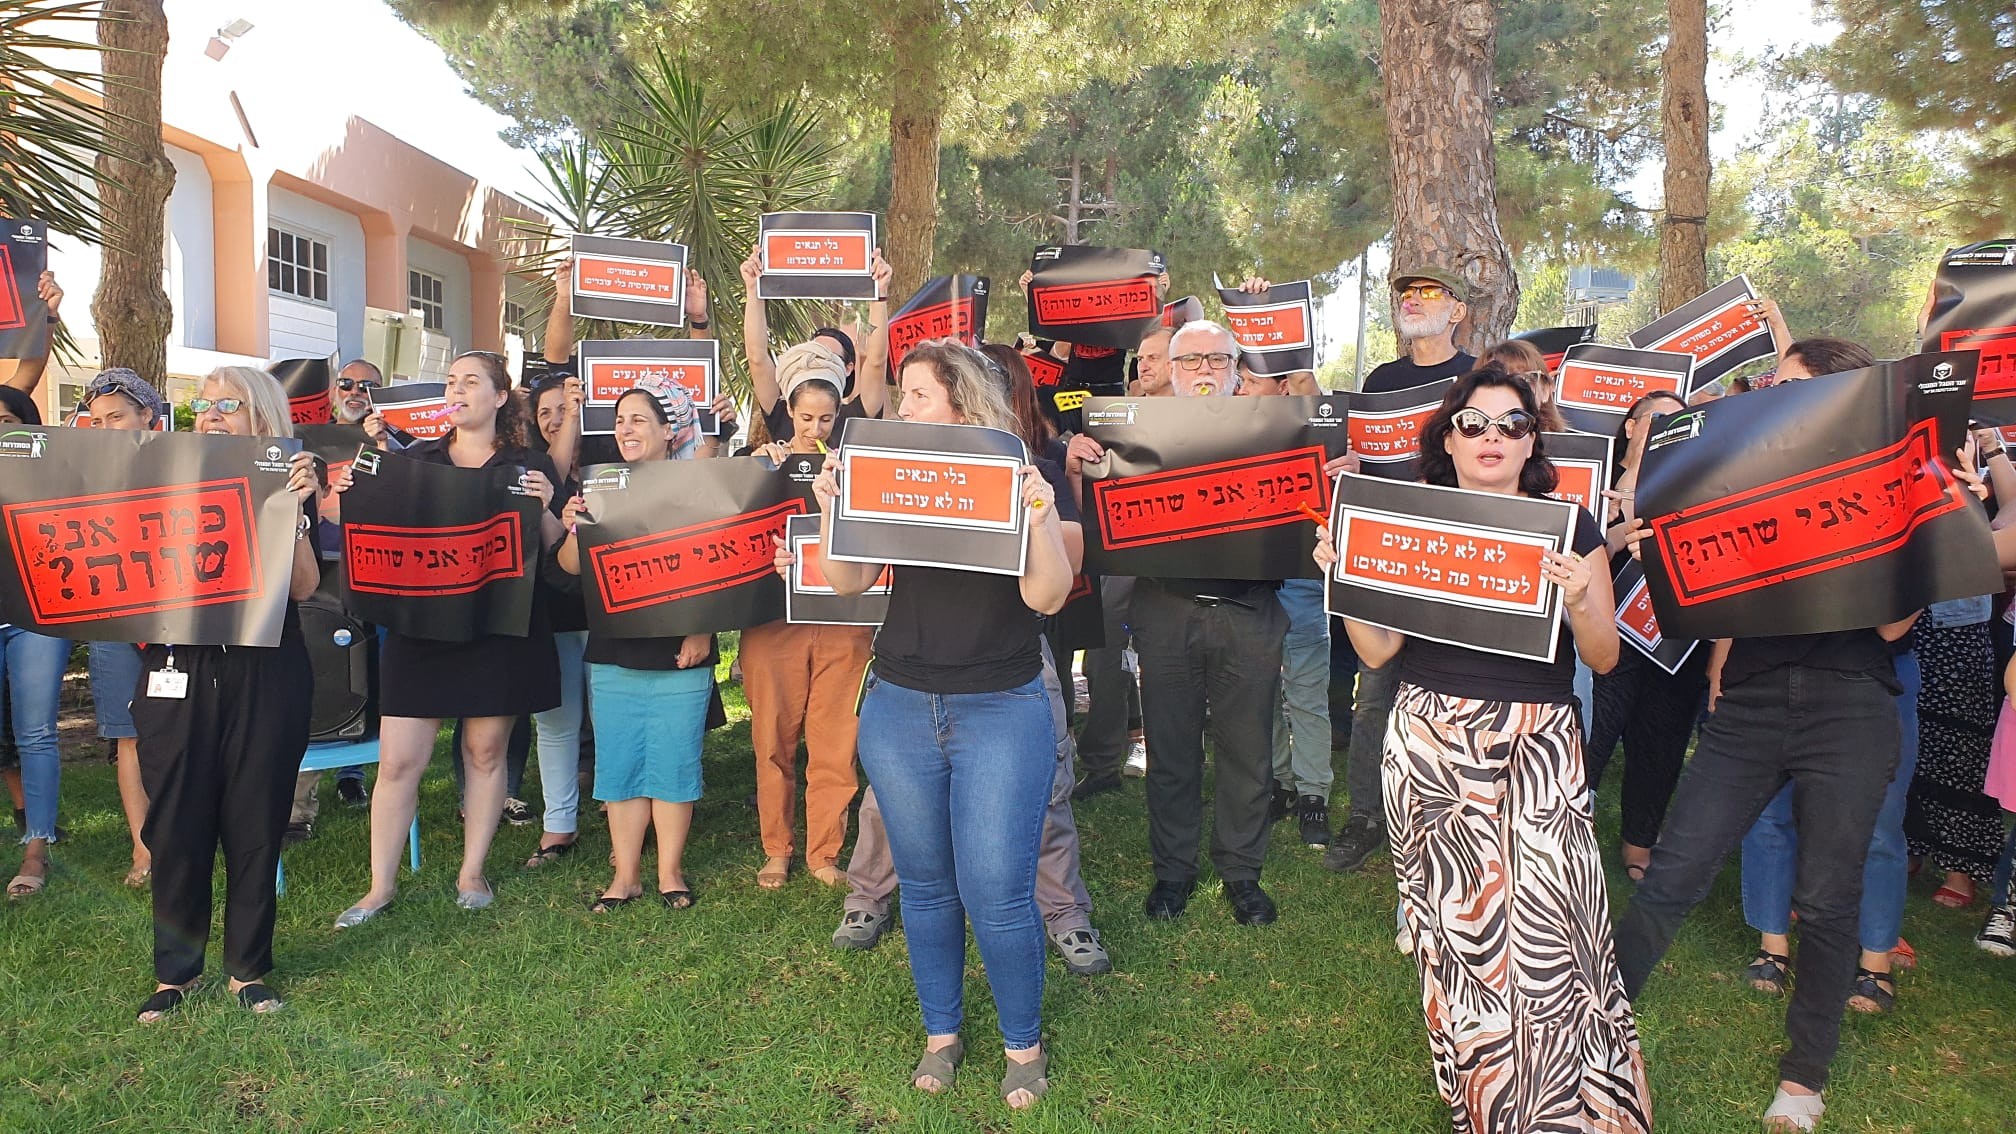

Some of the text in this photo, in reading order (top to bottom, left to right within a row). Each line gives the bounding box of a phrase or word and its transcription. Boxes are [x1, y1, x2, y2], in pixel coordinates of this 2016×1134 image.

[795, 238, 838, 250] בלי תנאים
[819, 254, 831, 265] לא
[833, 256, 844, 265] זה
[638, 265, 649, 278] לא
[613, 277, 627, 289] בלי
[658, 284, 670, 293] אין
[1042, 290, 1149, 312] כמה אני שווה?
[896, 311, 969, 340] כמה אני
[1250, 315, 1274, 327] חברי
[1711, 319, 1723, 332] לא
[1738, 319, 1753, 331] אין
[1242, 333, 1265, 342] שווה
[1267, 331, 1284, 341] אני
[612, 369, 637, 380] נעים
[672, 367, 686, 380] לא
[1594, 374, 1645, 389] בלי תנאים
[1619, 391, 1633, 403] לא
[439, 421, 451, 433] לא
[1364, 418, 1415, 434] בלי תנאים
[1393, 436, 1408, 449] לא
[895, 466, 967, 485] בלי תנאים
[881, 491, 975, 511] זה לא עובד!!!
[1111, 472, 1313, 521] כמה אני שווה?
[1795, 492, 1869, 529] אני
[39, 504, 226, 550] כמה אני
[1381, 531, 1507, 563] לא לא לא נעים
[1679, 518, 1778, 565] שווה?
[355, 535, 508, 569] כמה אני שווה?
[692, 539, 739, 564] אני
[49, 540, 229, 600] שווה?
[609, 553, 681, 584] שווה?
[1353, 554, 1532, 595] לעבוד פה בלי תנאים!
